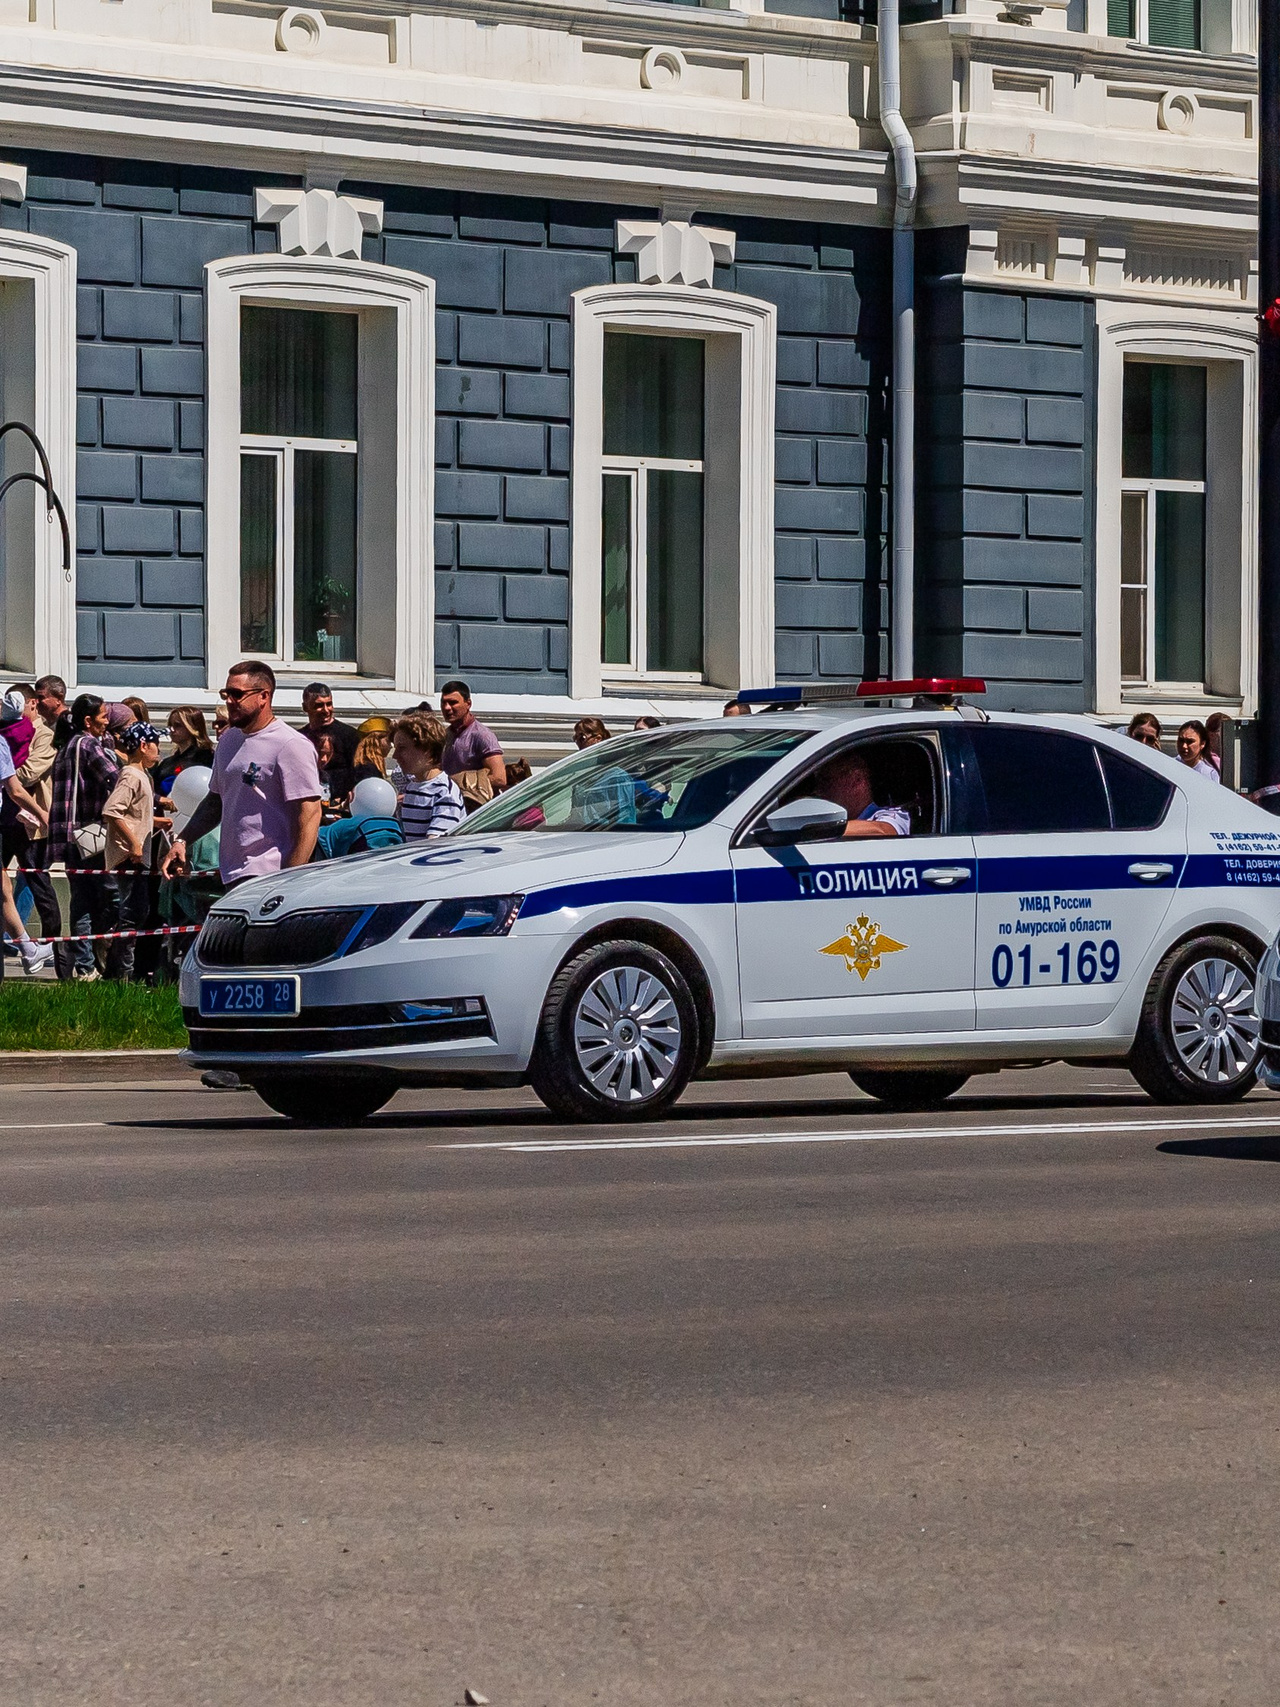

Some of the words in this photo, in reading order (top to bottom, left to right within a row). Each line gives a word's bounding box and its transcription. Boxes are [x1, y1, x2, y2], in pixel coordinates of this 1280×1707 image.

[1209, 832, 1231, 840] ТЕЛ.
[1231, 832, 1278, 841] ДЕЖУРНОЙ
[1216, 843, 1224, 851] 8
[1224, 843, 1252, 852] (4162)
[1223, 859, 1243, 868] ТЕЛ.
[798, 867, 919, 895] ПОЛИЦИЯ
[1226, 872, 1233, 882] 8
[1234, 873, 1261, 884] (4162)
[1018, 896, 1052, 913] УМВД
[1053, 895, 1092, 910] России
[998, 922, 1013, 935] по
[1014, 918, 1067, 937] Амурской
[1069, 916, 1112, 933] области
[991, 939, 1121, 988] 01-169
[224, 984, 264, 1009] 2258
[274, 982, 290, 1002] 28
